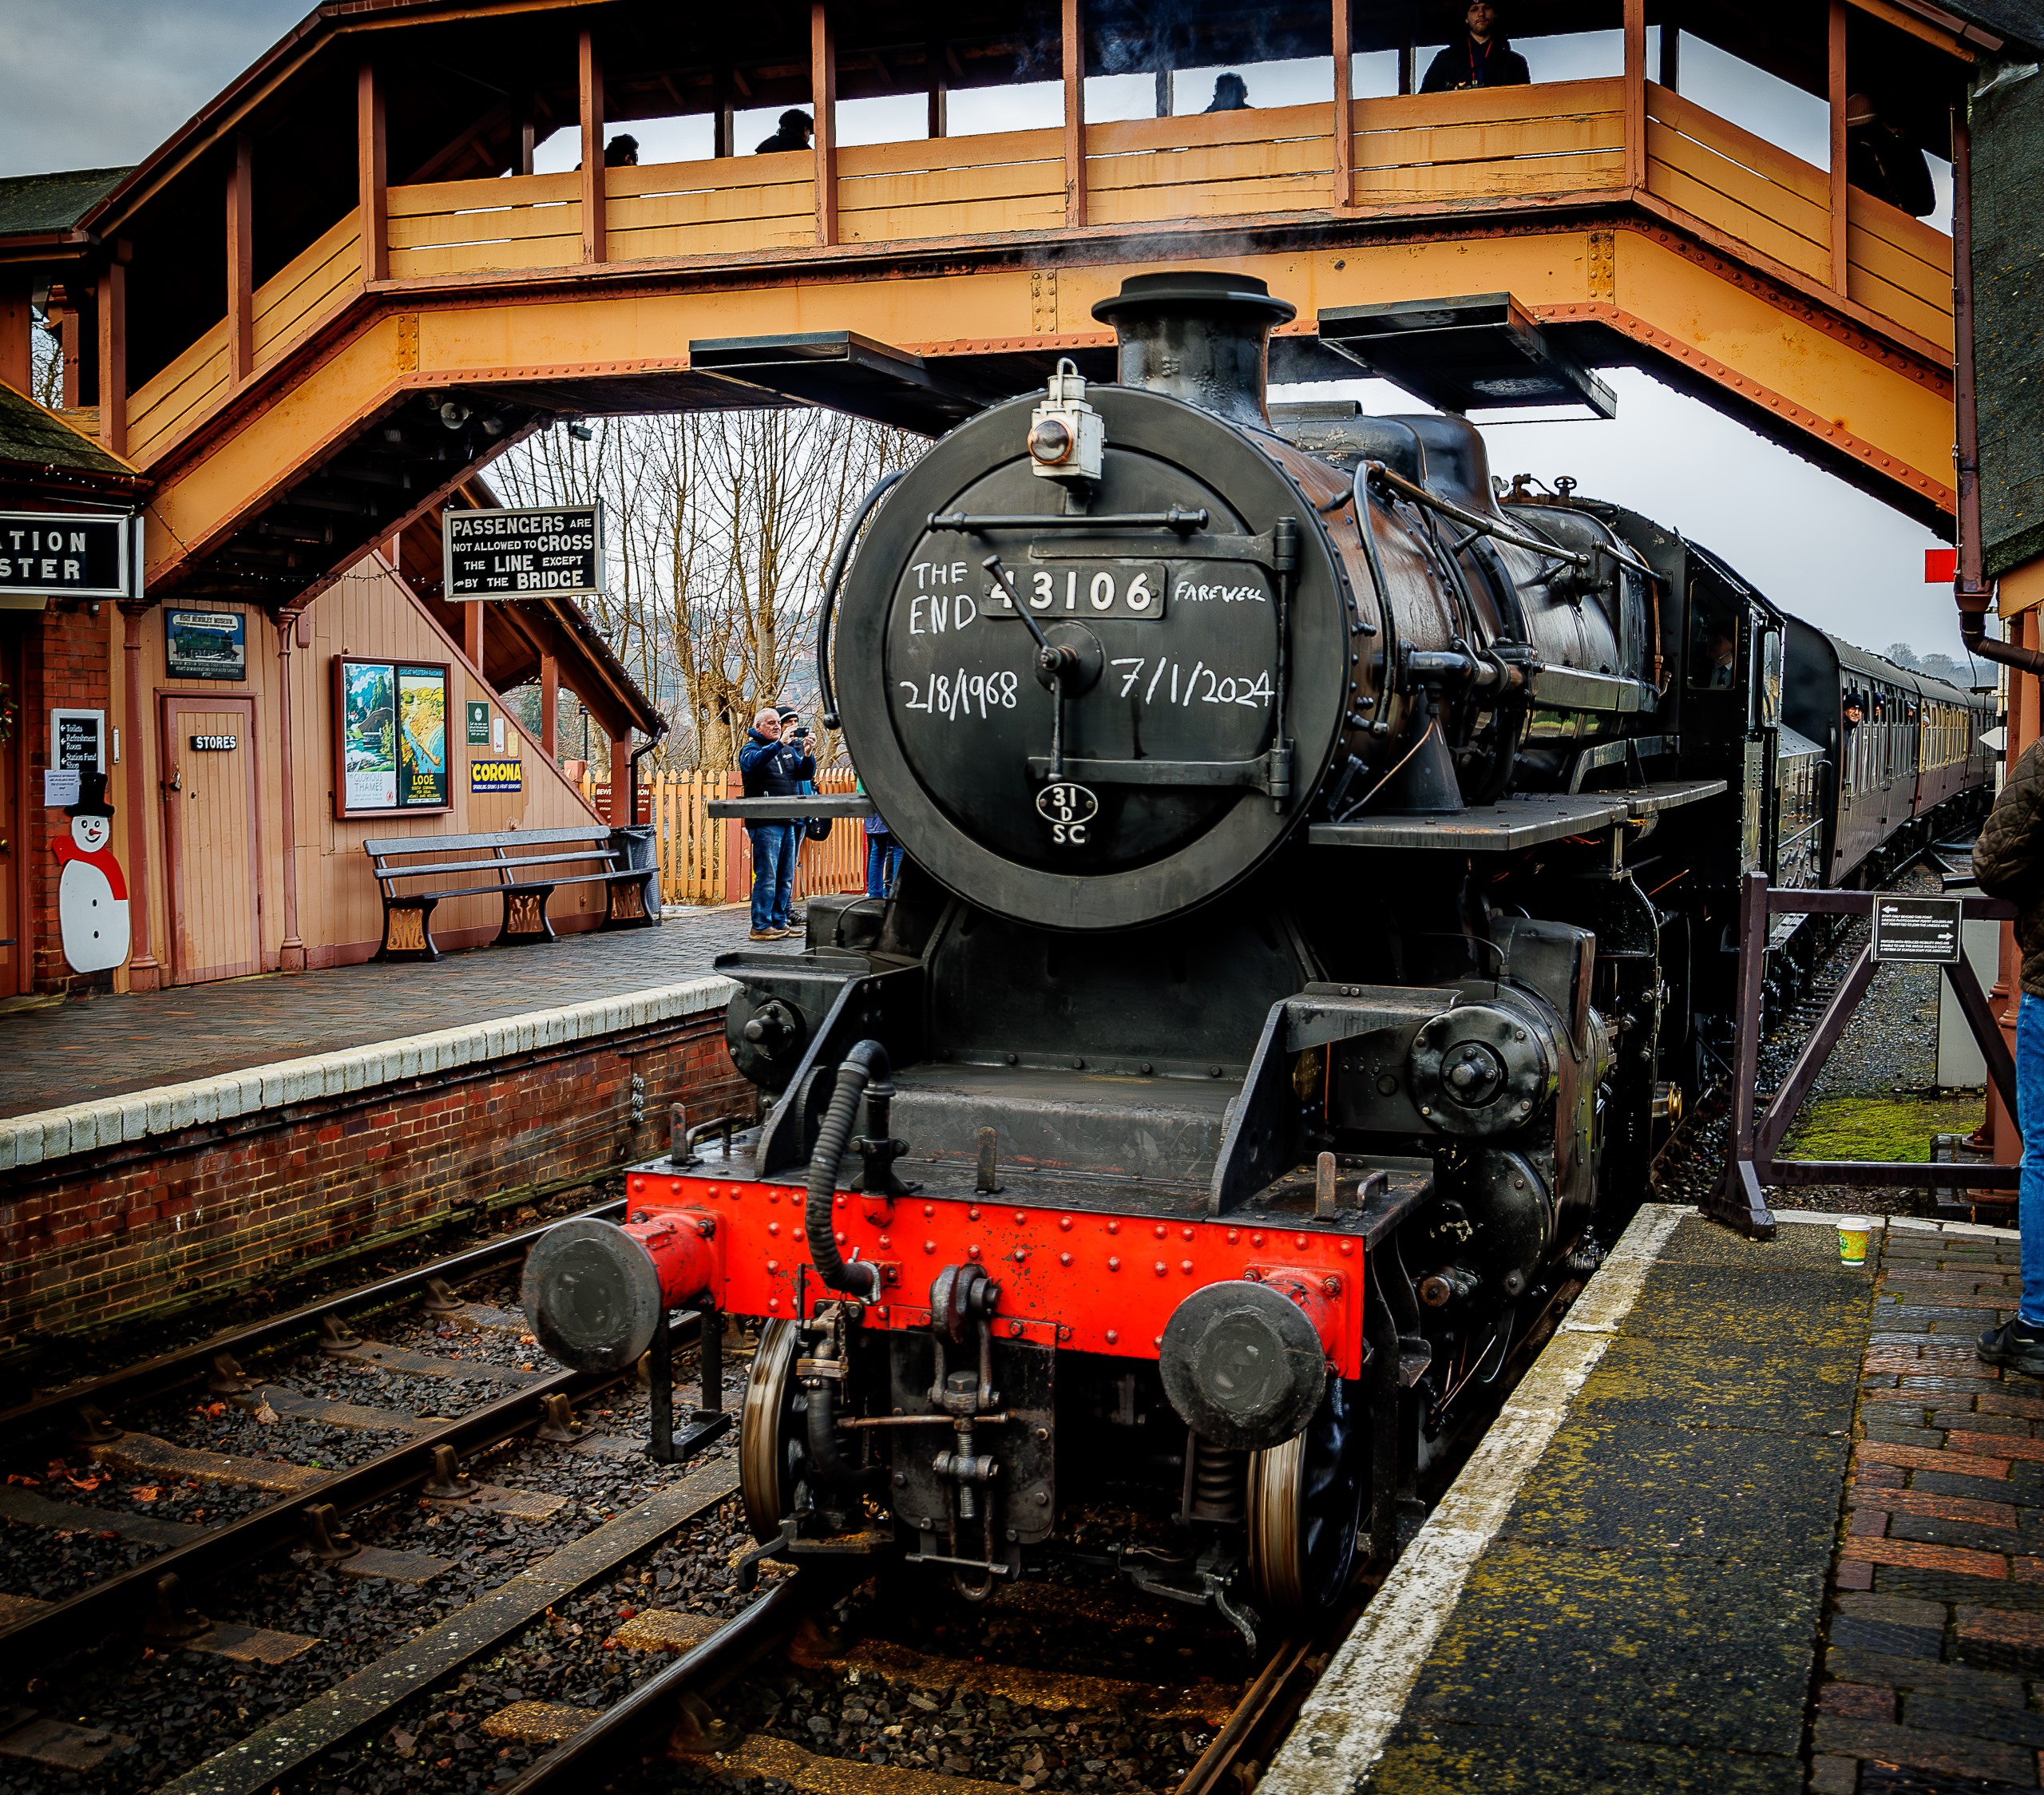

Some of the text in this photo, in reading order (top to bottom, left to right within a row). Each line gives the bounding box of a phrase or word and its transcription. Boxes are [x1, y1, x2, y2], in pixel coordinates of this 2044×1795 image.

[452, 516, 592, 537] PASSENGERS ARE
[0, 530, 86, 553] TION
[453, 535, 593, 552] NOT ALLOWED TO CROSS
[463, 554, 583, 573] THE LINE EXCEPT
[464, 570, 584, 589] BY THE BRIDGE
[912, 561, 969, 590] THE
[990, 570, 1152, 611] 43106
[1174, 580, 1267, 603] FAREWELL
[909, 596, 977, 635] END
[1111, 656, 1276, 708] 7/1/2024
[899, 668, 1019, 721] 2/8/1968
[66, 724, 83, 733] Toilets
[196, 736, 236, 749] STORES
[354, 782, 383, 792] THAMES
[412, 774, 434, 786] LOOE
[1052, 787, 1076, 807] 31
[1061, 806, 1073, 822] D
[1053, 824, 1086, 844] SC
